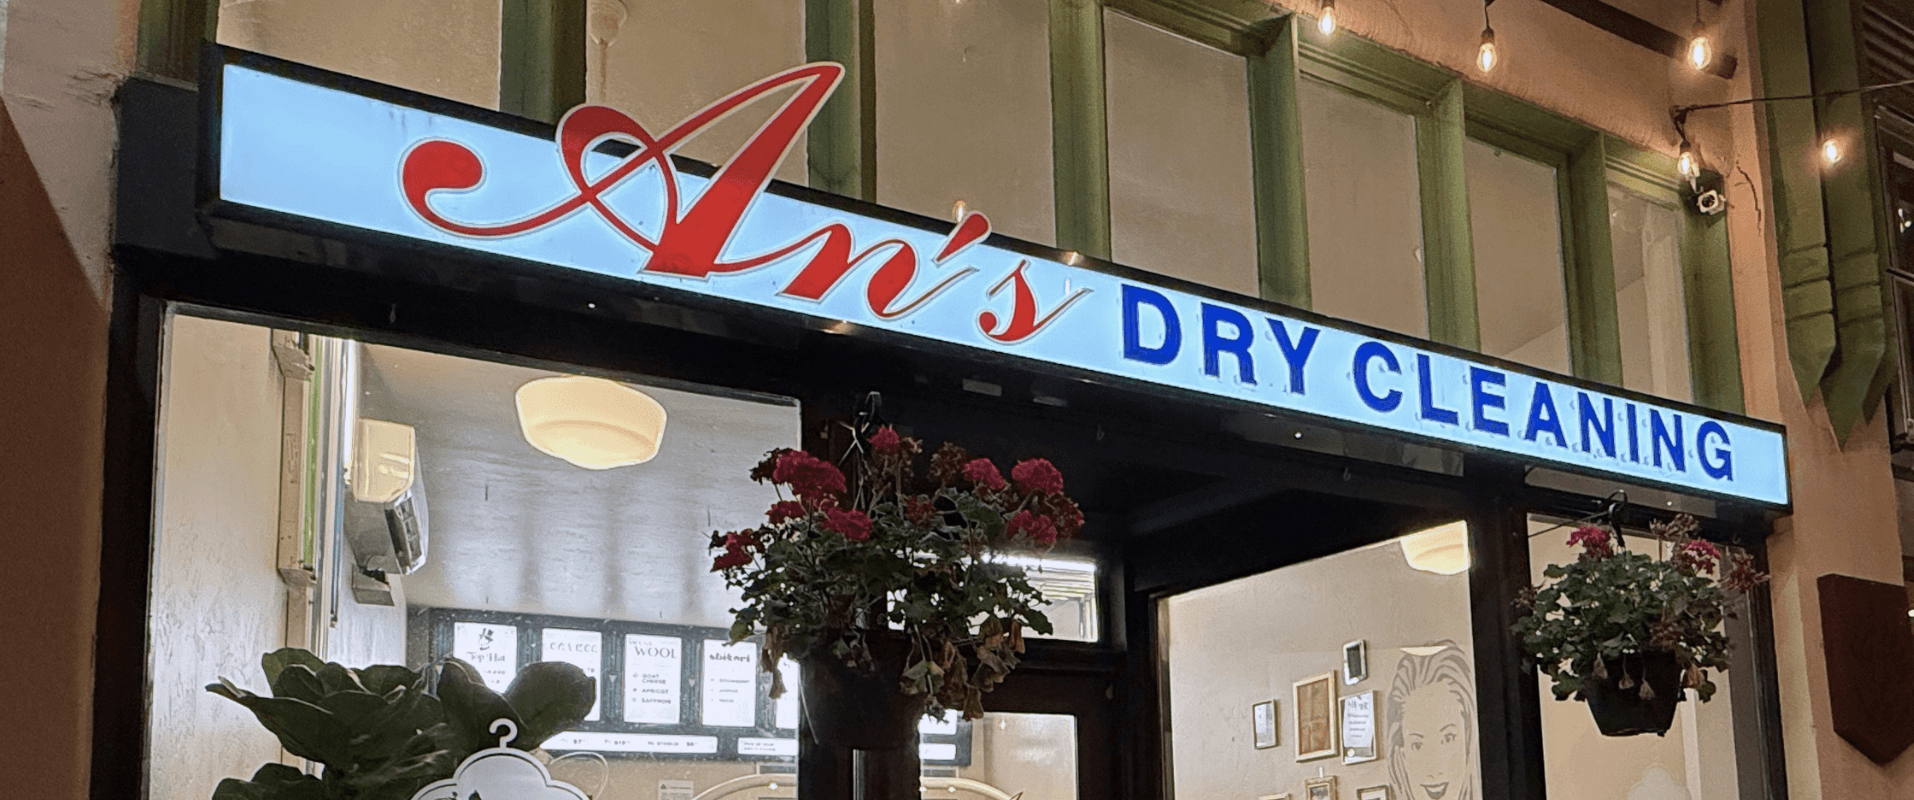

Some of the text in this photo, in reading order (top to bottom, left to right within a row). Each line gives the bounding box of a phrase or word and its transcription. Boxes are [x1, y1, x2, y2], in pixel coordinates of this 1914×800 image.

[399, 61, 1735, 482] An's DRY CLEANING
[634, 646, 678, 659] WOOL
